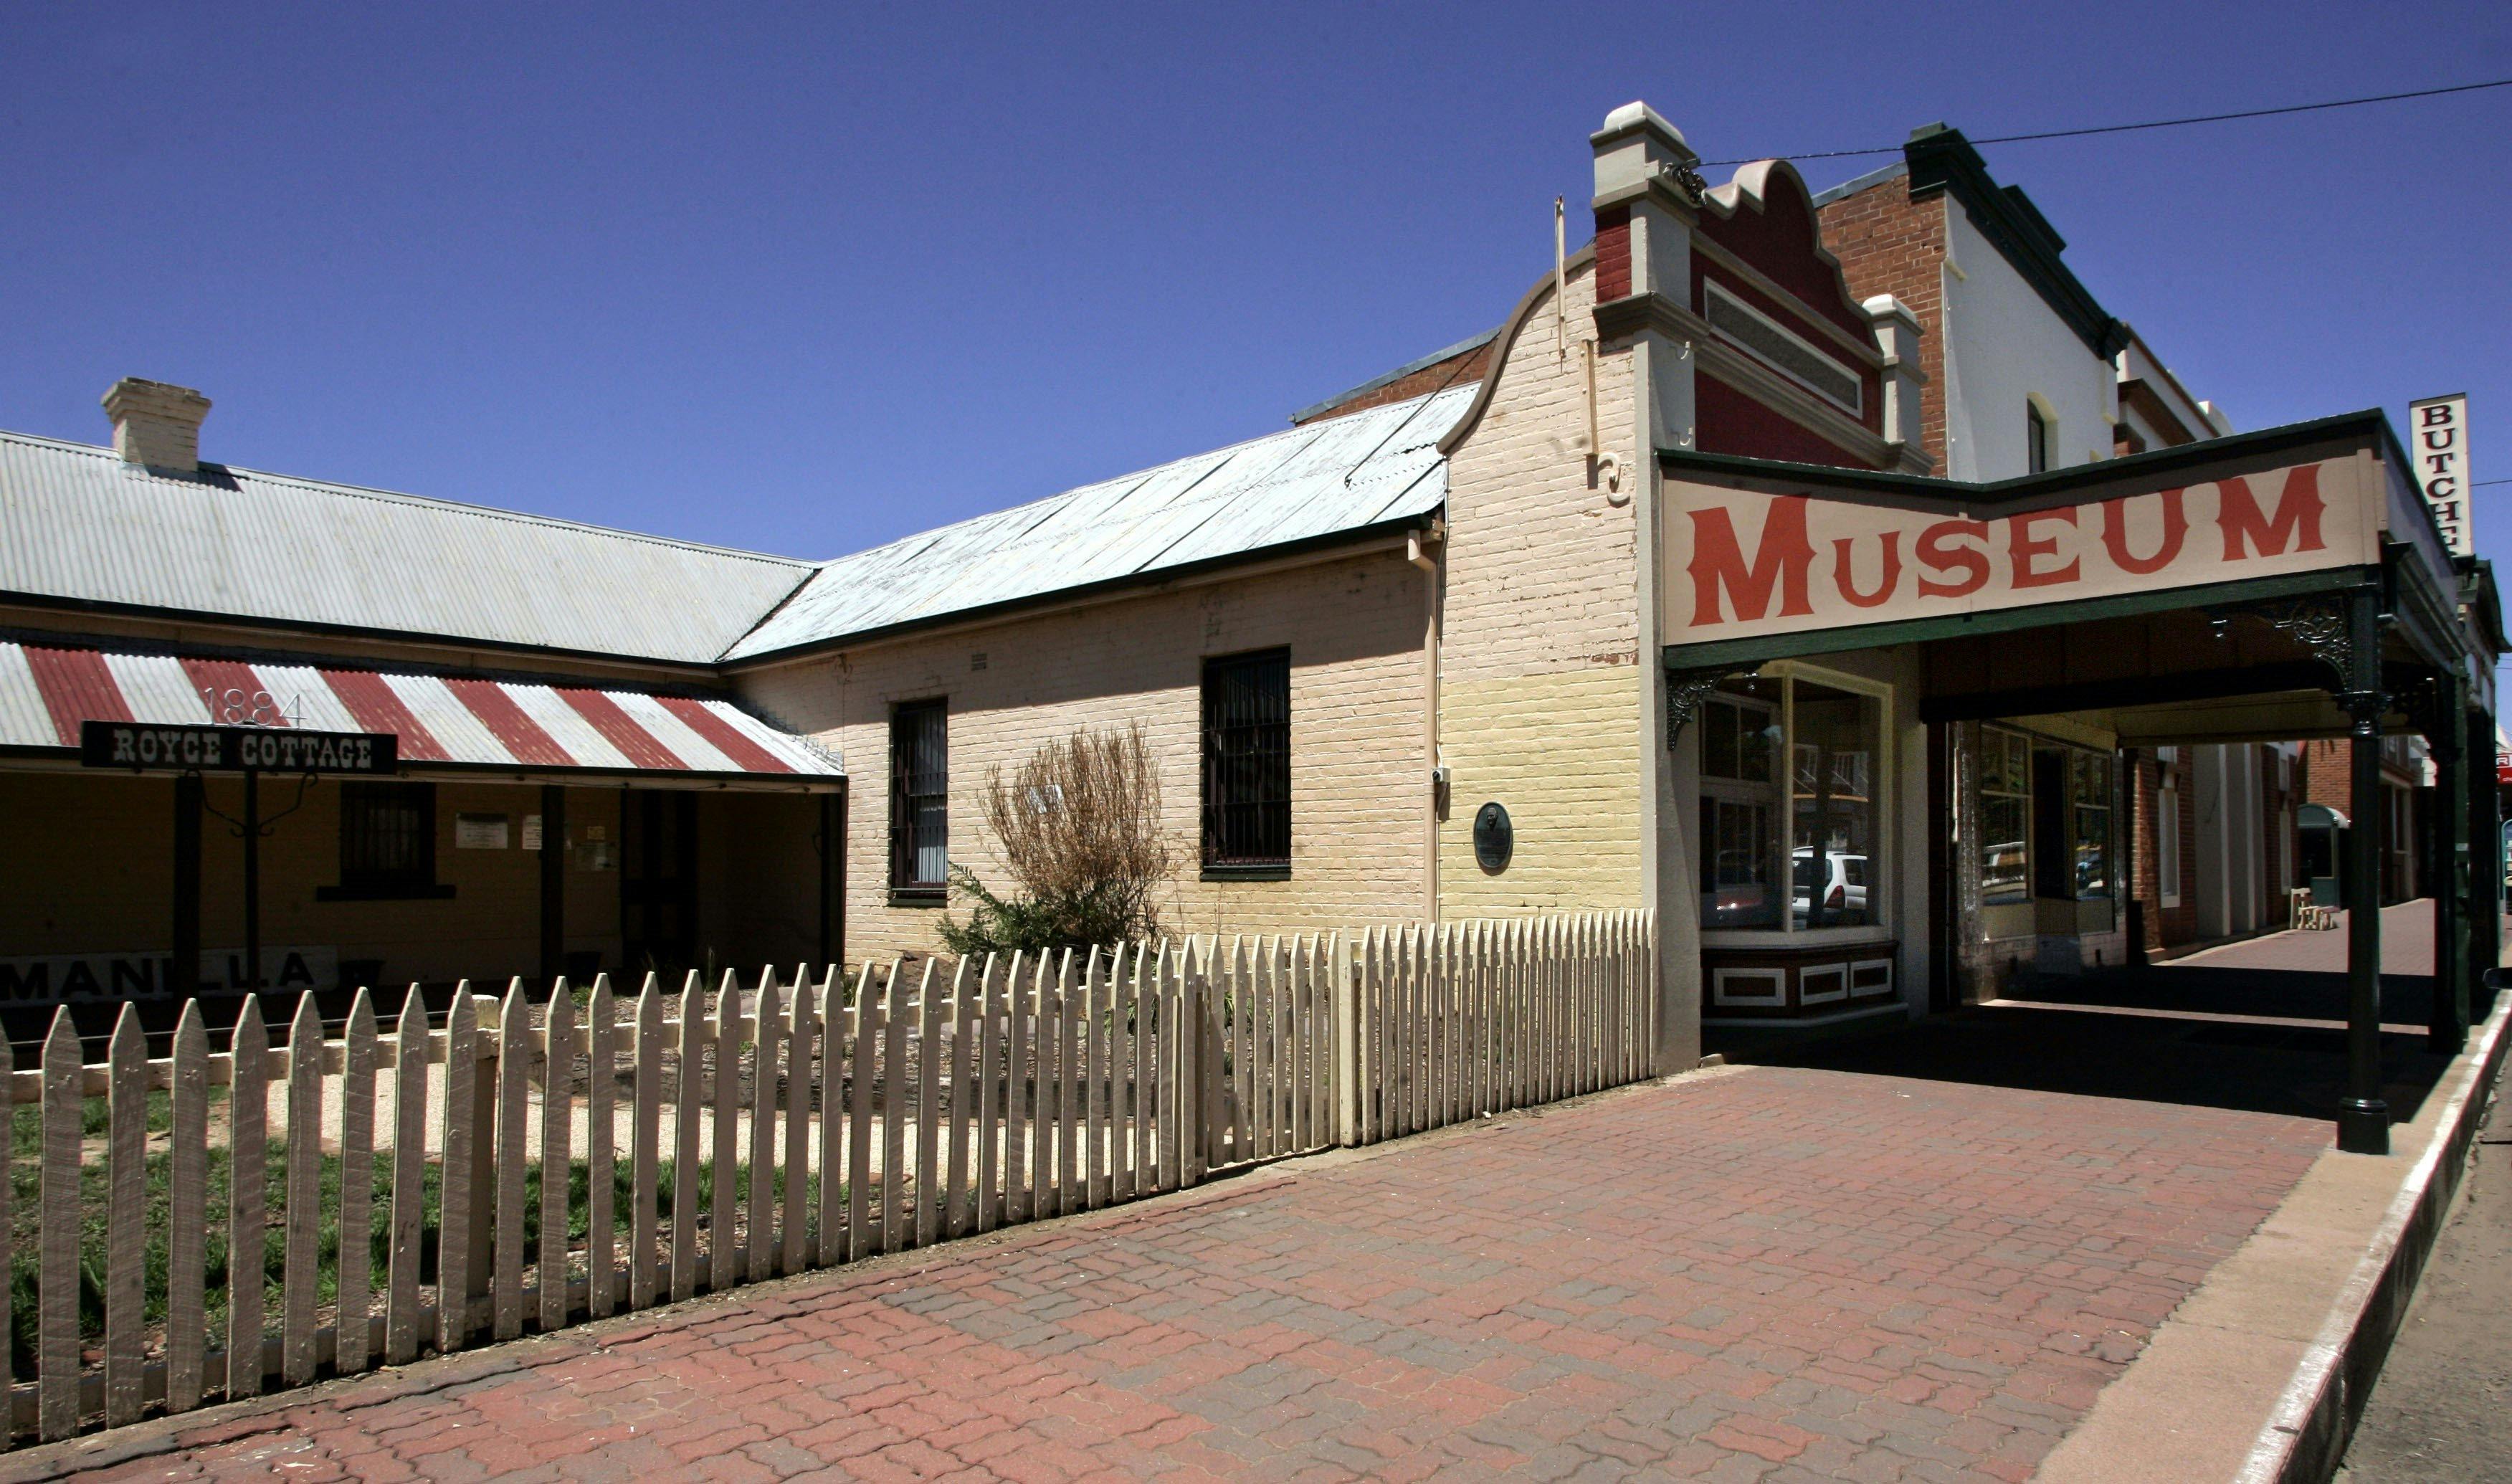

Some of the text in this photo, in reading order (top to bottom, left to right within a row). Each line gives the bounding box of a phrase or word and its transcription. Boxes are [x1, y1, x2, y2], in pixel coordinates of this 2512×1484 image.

[2420, 404, 2460, 558] BUTCHE
[1685, 463, 2328, 627] MUSEUM
[113, 728, 372, 769] ROYCE COTTAGE
[204, 688, 308, 730] 1884
